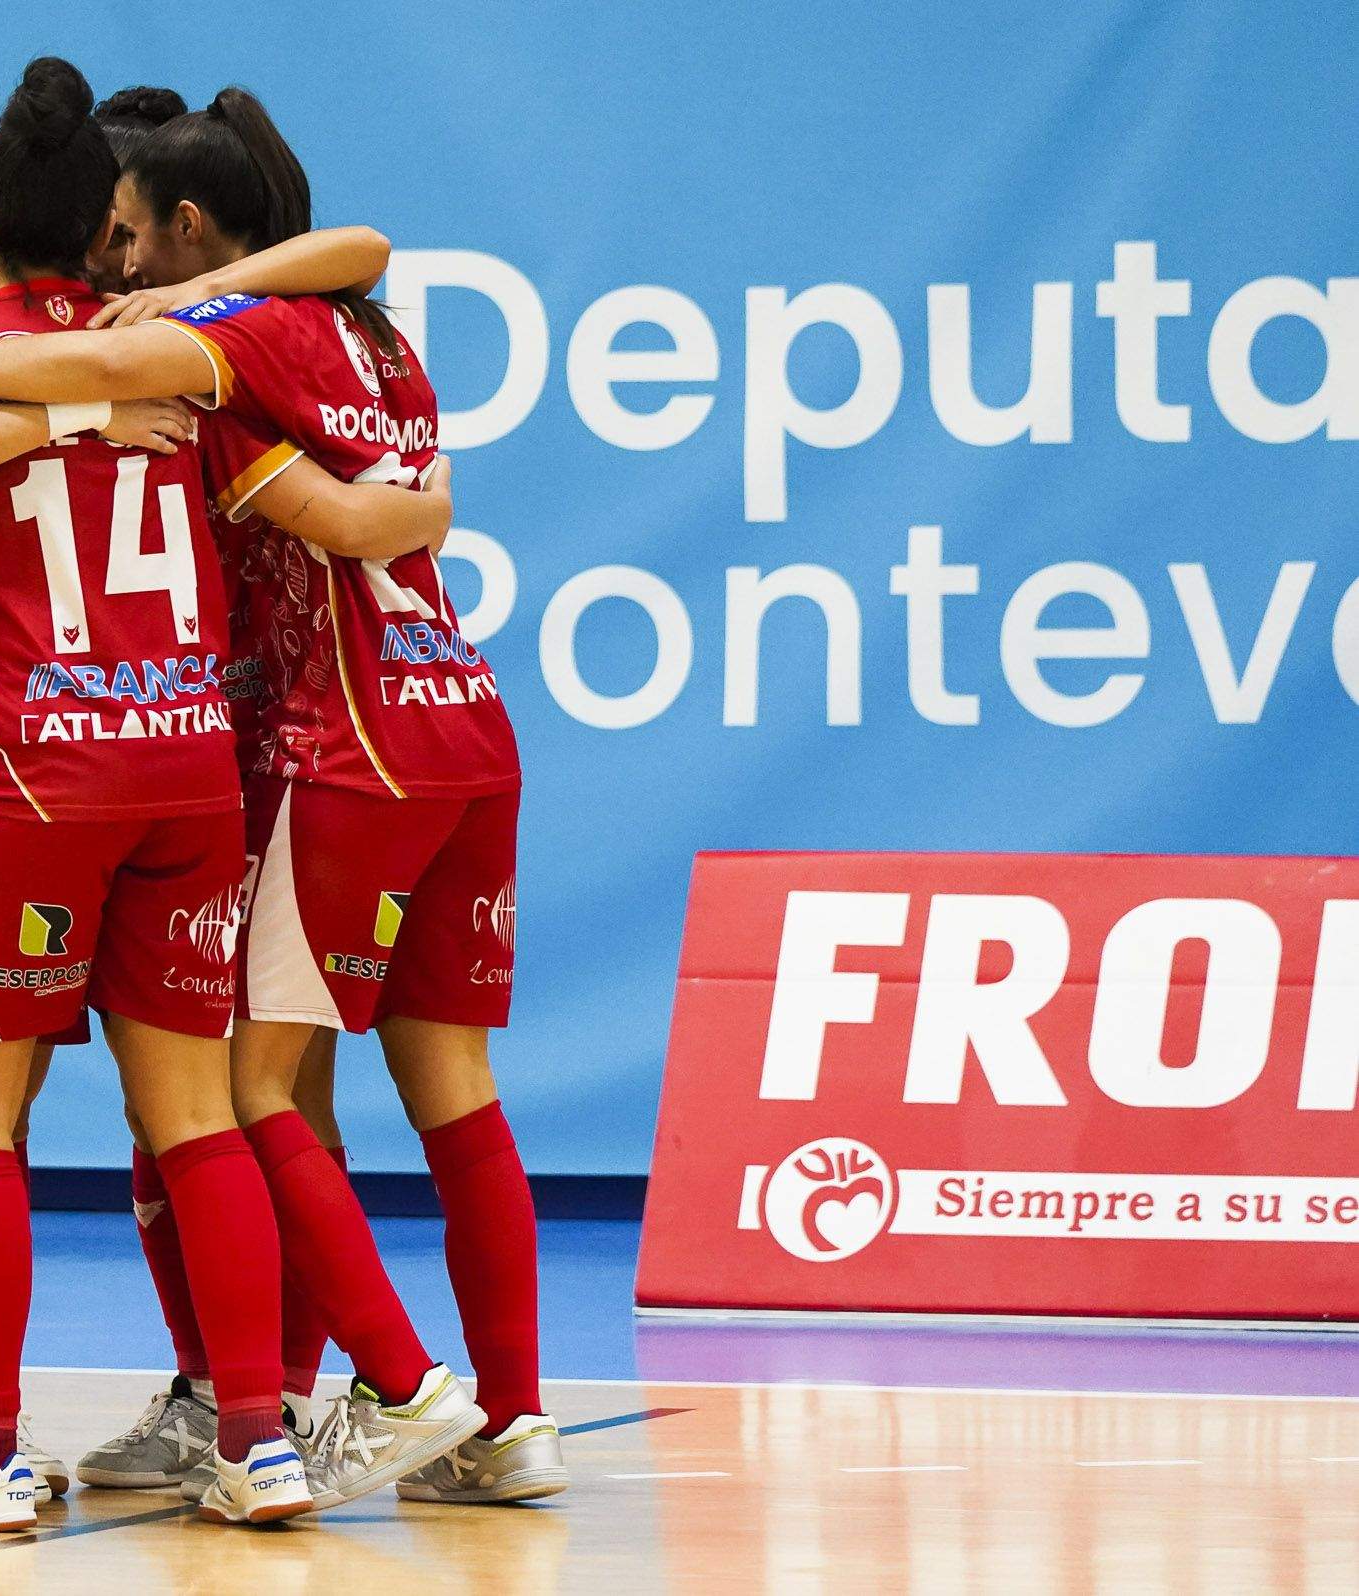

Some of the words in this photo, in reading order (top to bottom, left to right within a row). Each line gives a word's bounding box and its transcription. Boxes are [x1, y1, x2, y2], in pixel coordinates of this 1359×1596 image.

[9, 453, 201, 655] 14
[439, 525, 1359, 729] ontev
[934, 1177, 1155, 1232] Siempre
[1176, 1192, 1203, 1223] a
[1225, 1192, 1283, 1224] su
[7, 1490, 36, 1501] TOP-
